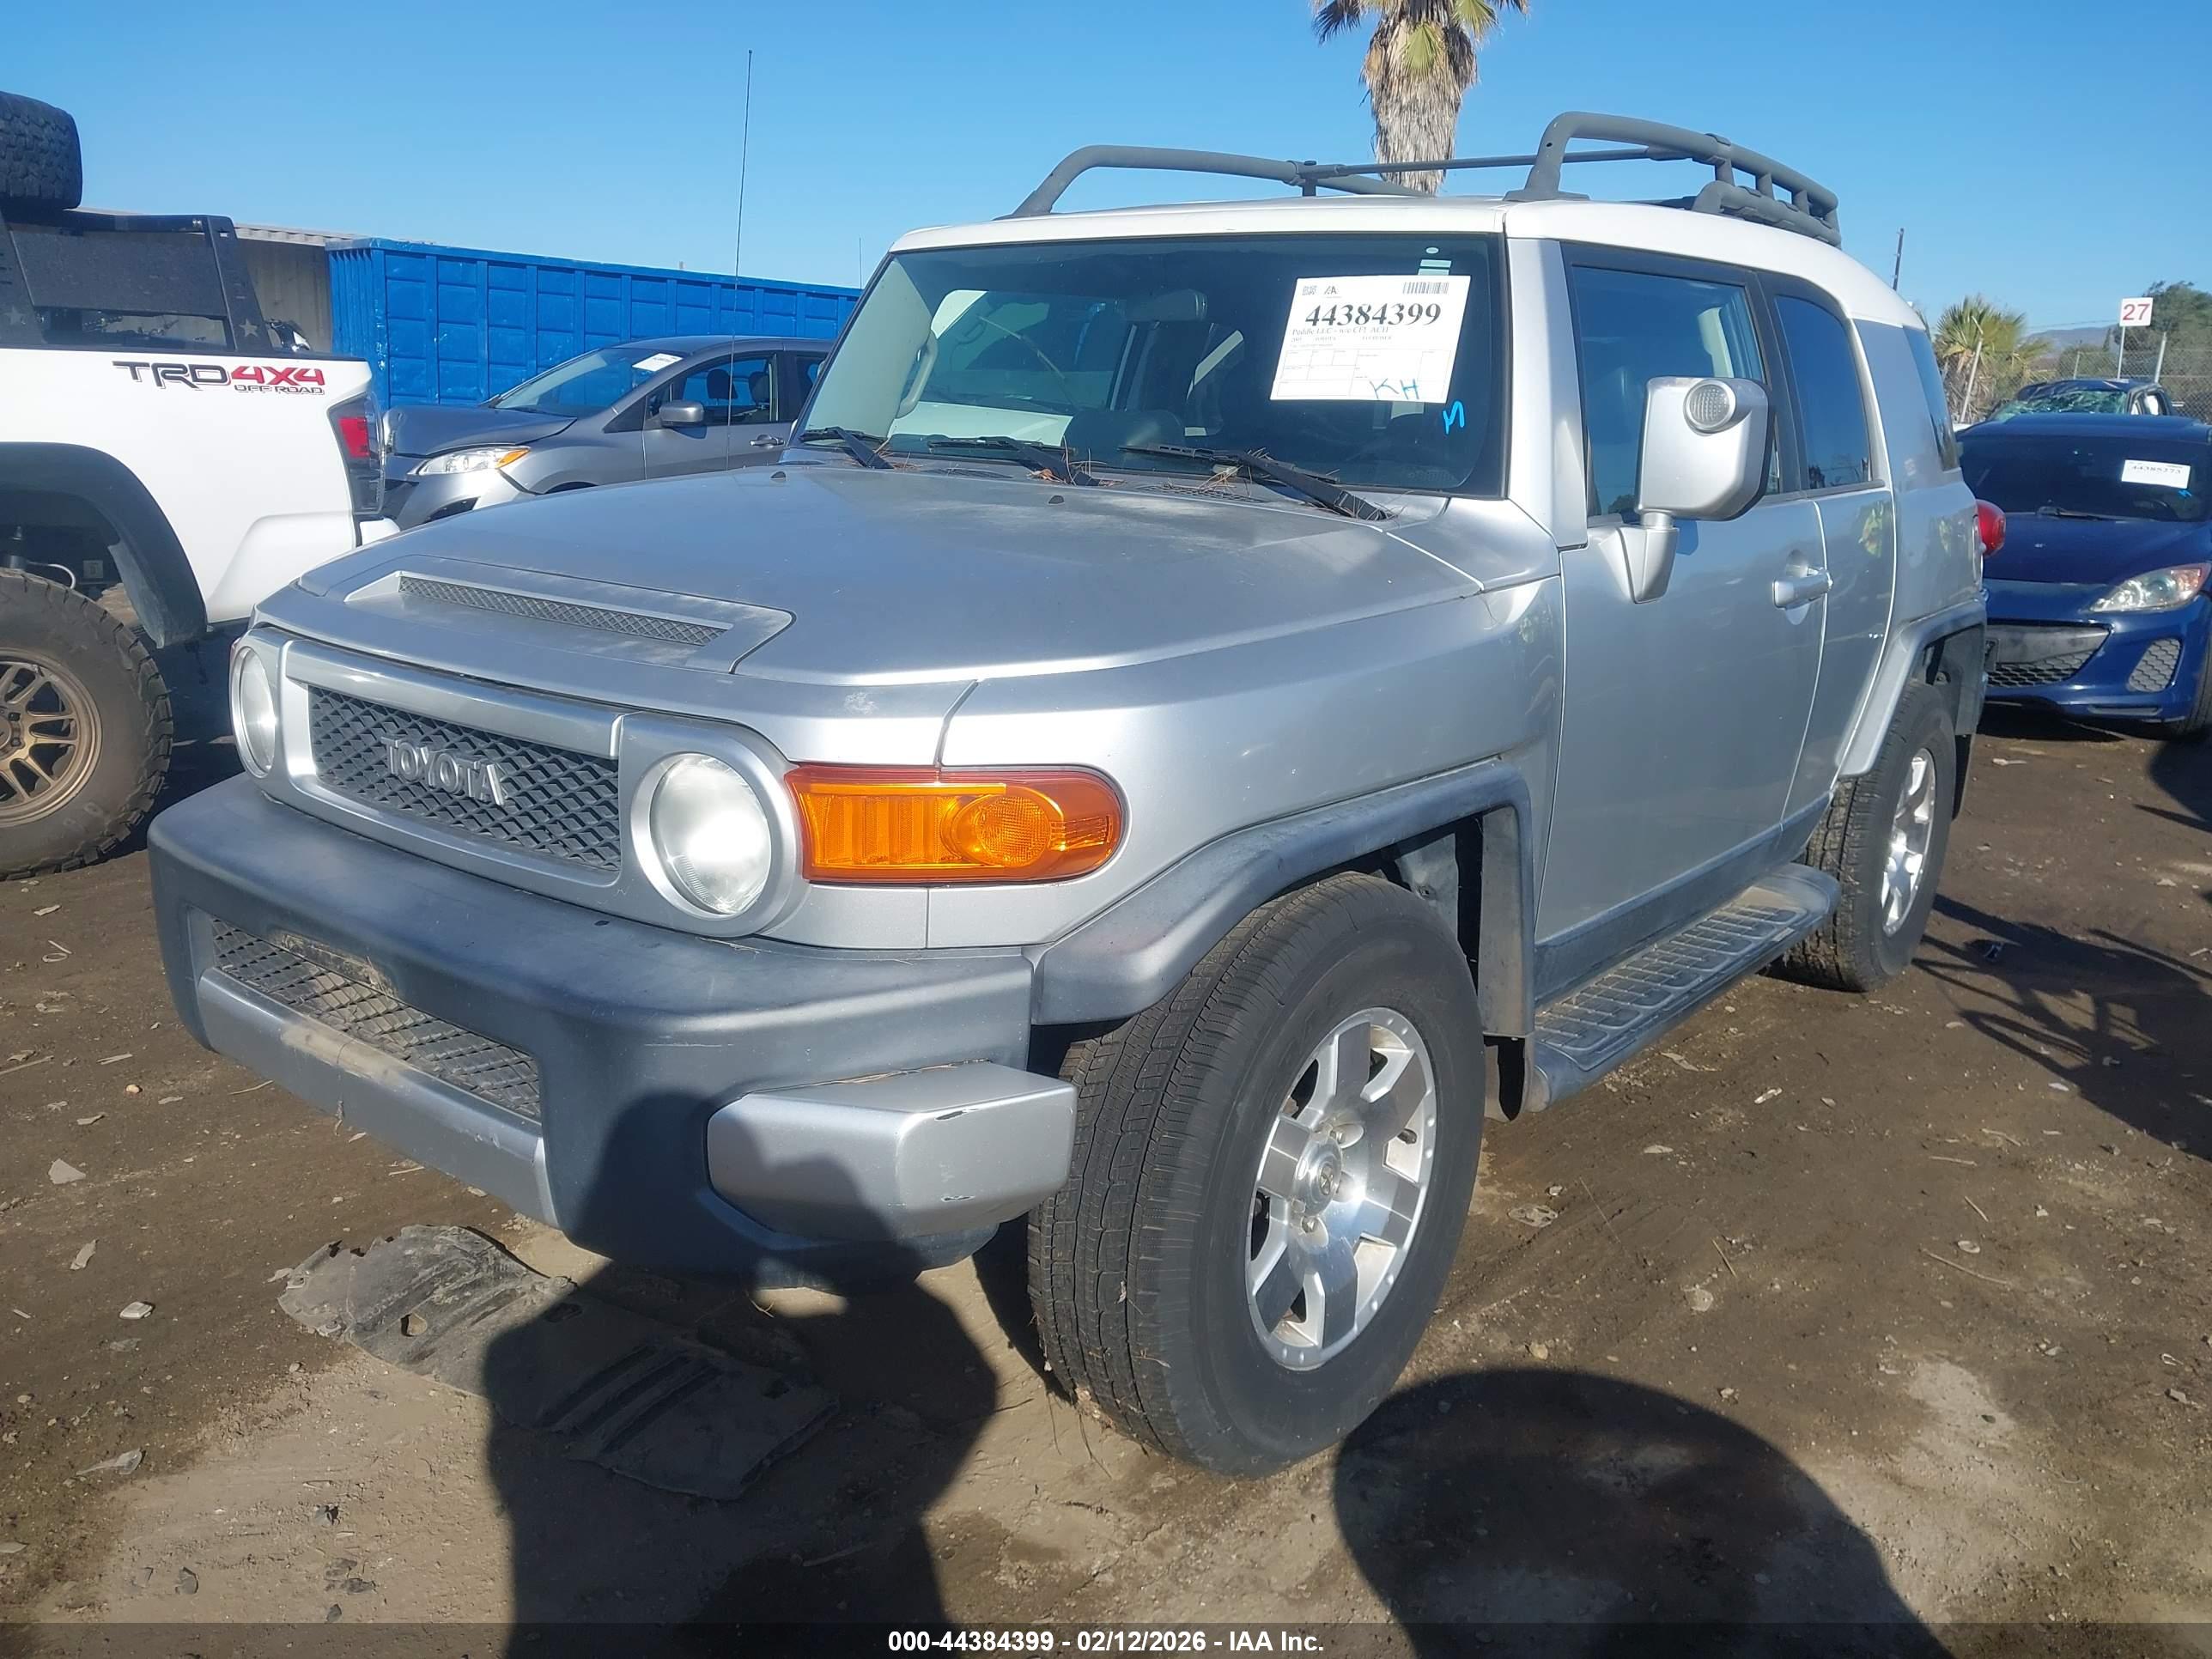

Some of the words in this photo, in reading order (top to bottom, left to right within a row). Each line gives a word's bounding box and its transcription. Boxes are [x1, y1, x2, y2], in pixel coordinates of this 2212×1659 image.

[1305, 303, 1442, 326] 44384399
[2122, 303, 2151, 321] 27
[112, 361, 231, 391] TRD
[234, 384, 271, 394] OFF
[274, 386, 325, 396] ROAD
[381, 735, 508, 805] TOYOTA
